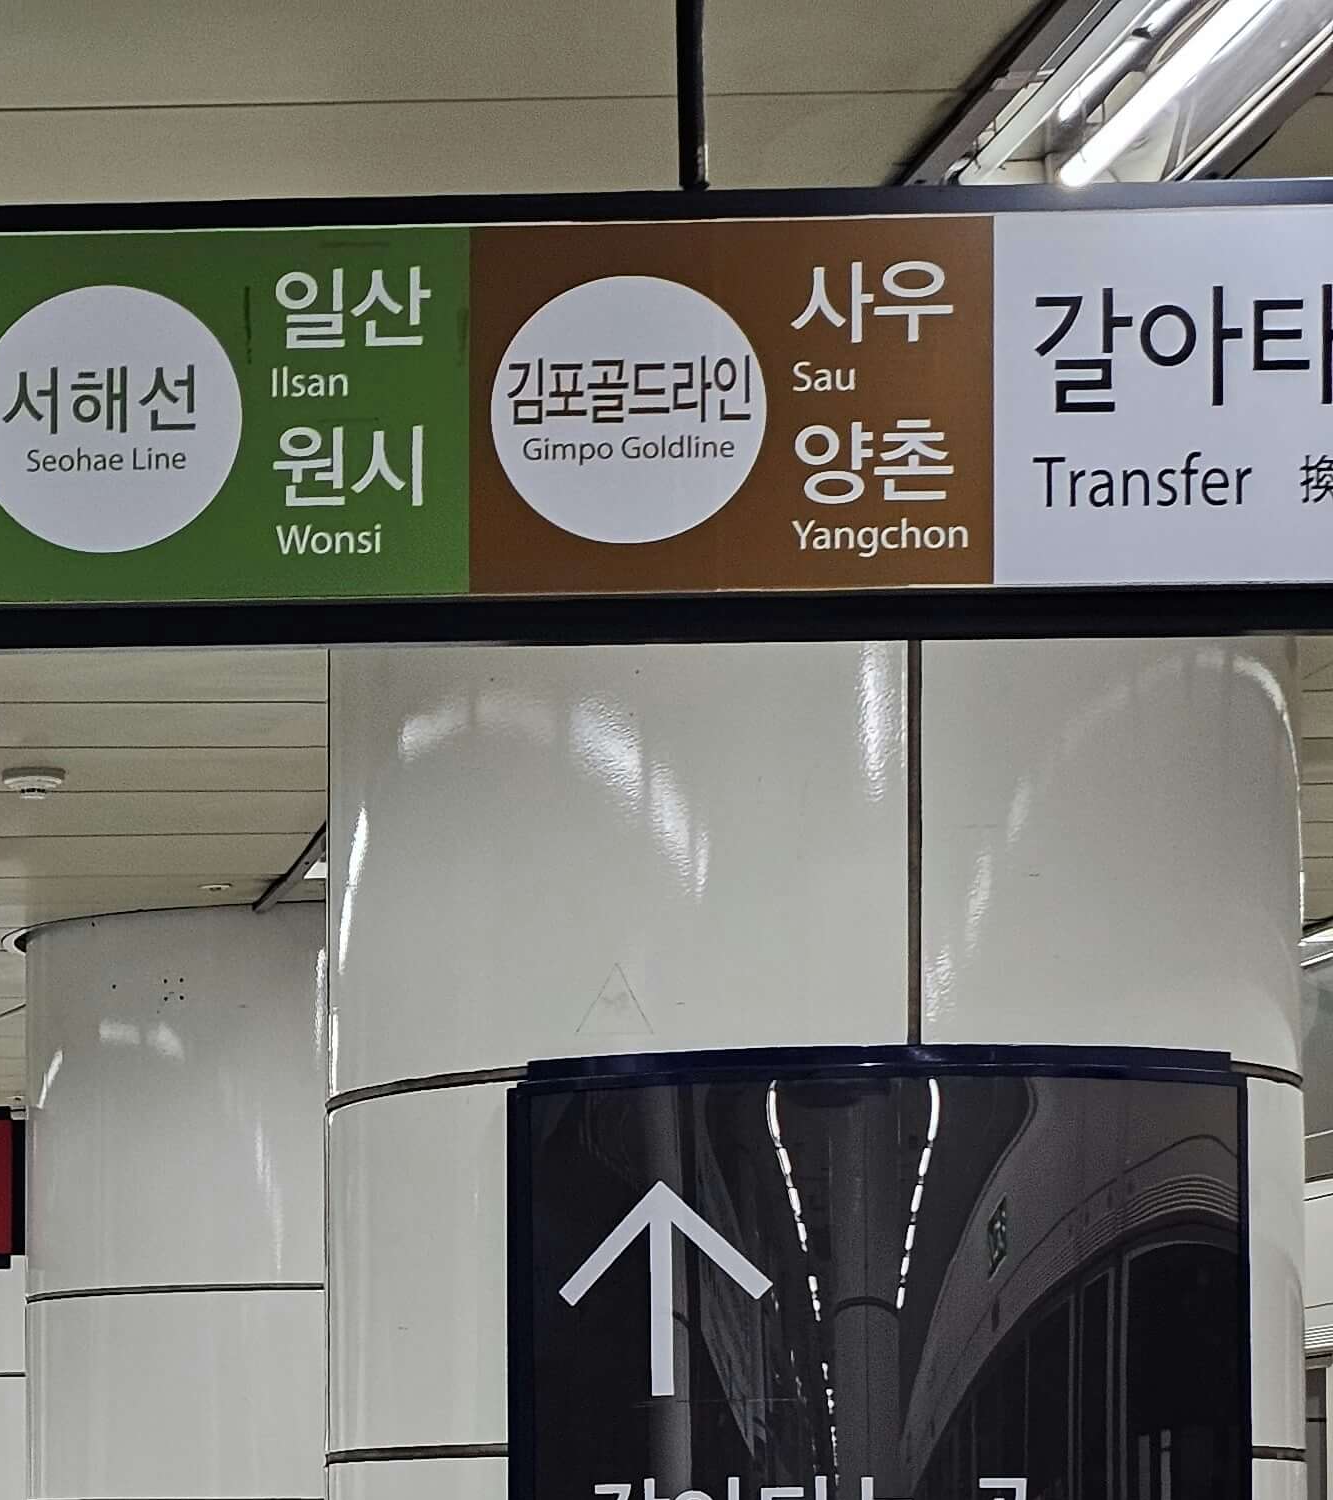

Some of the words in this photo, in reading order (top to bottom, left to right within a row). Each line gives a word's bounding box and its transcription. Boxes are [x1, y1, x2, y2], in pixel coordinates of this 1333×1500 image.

[275, 265, 432, 349] 일산
[790, 260, 954, 344] 사우
[792, 361, 856, 392] Sau
[1034, 283, 1333, 413] 갈아타
[2, 364, 197, 435] 서해선
[271, 365, 349, 398] Ilsan
[507, 354, 752, 426] 김포골드라인
[26, 447, 124, 473] Seohae
[132, 447, 187, 471] Line
[272, 424, 424, 507] 원시
[522, 437, 614, 466] Gimpo
[620, 434, 735, 460] Goldline
[794, 418, 955, 505] 양촌
[1032, 451, 1253, 508] Transfer
[275, 523, 382, 555] Wonsi
[791, 517, 969, 558] Yangchon
